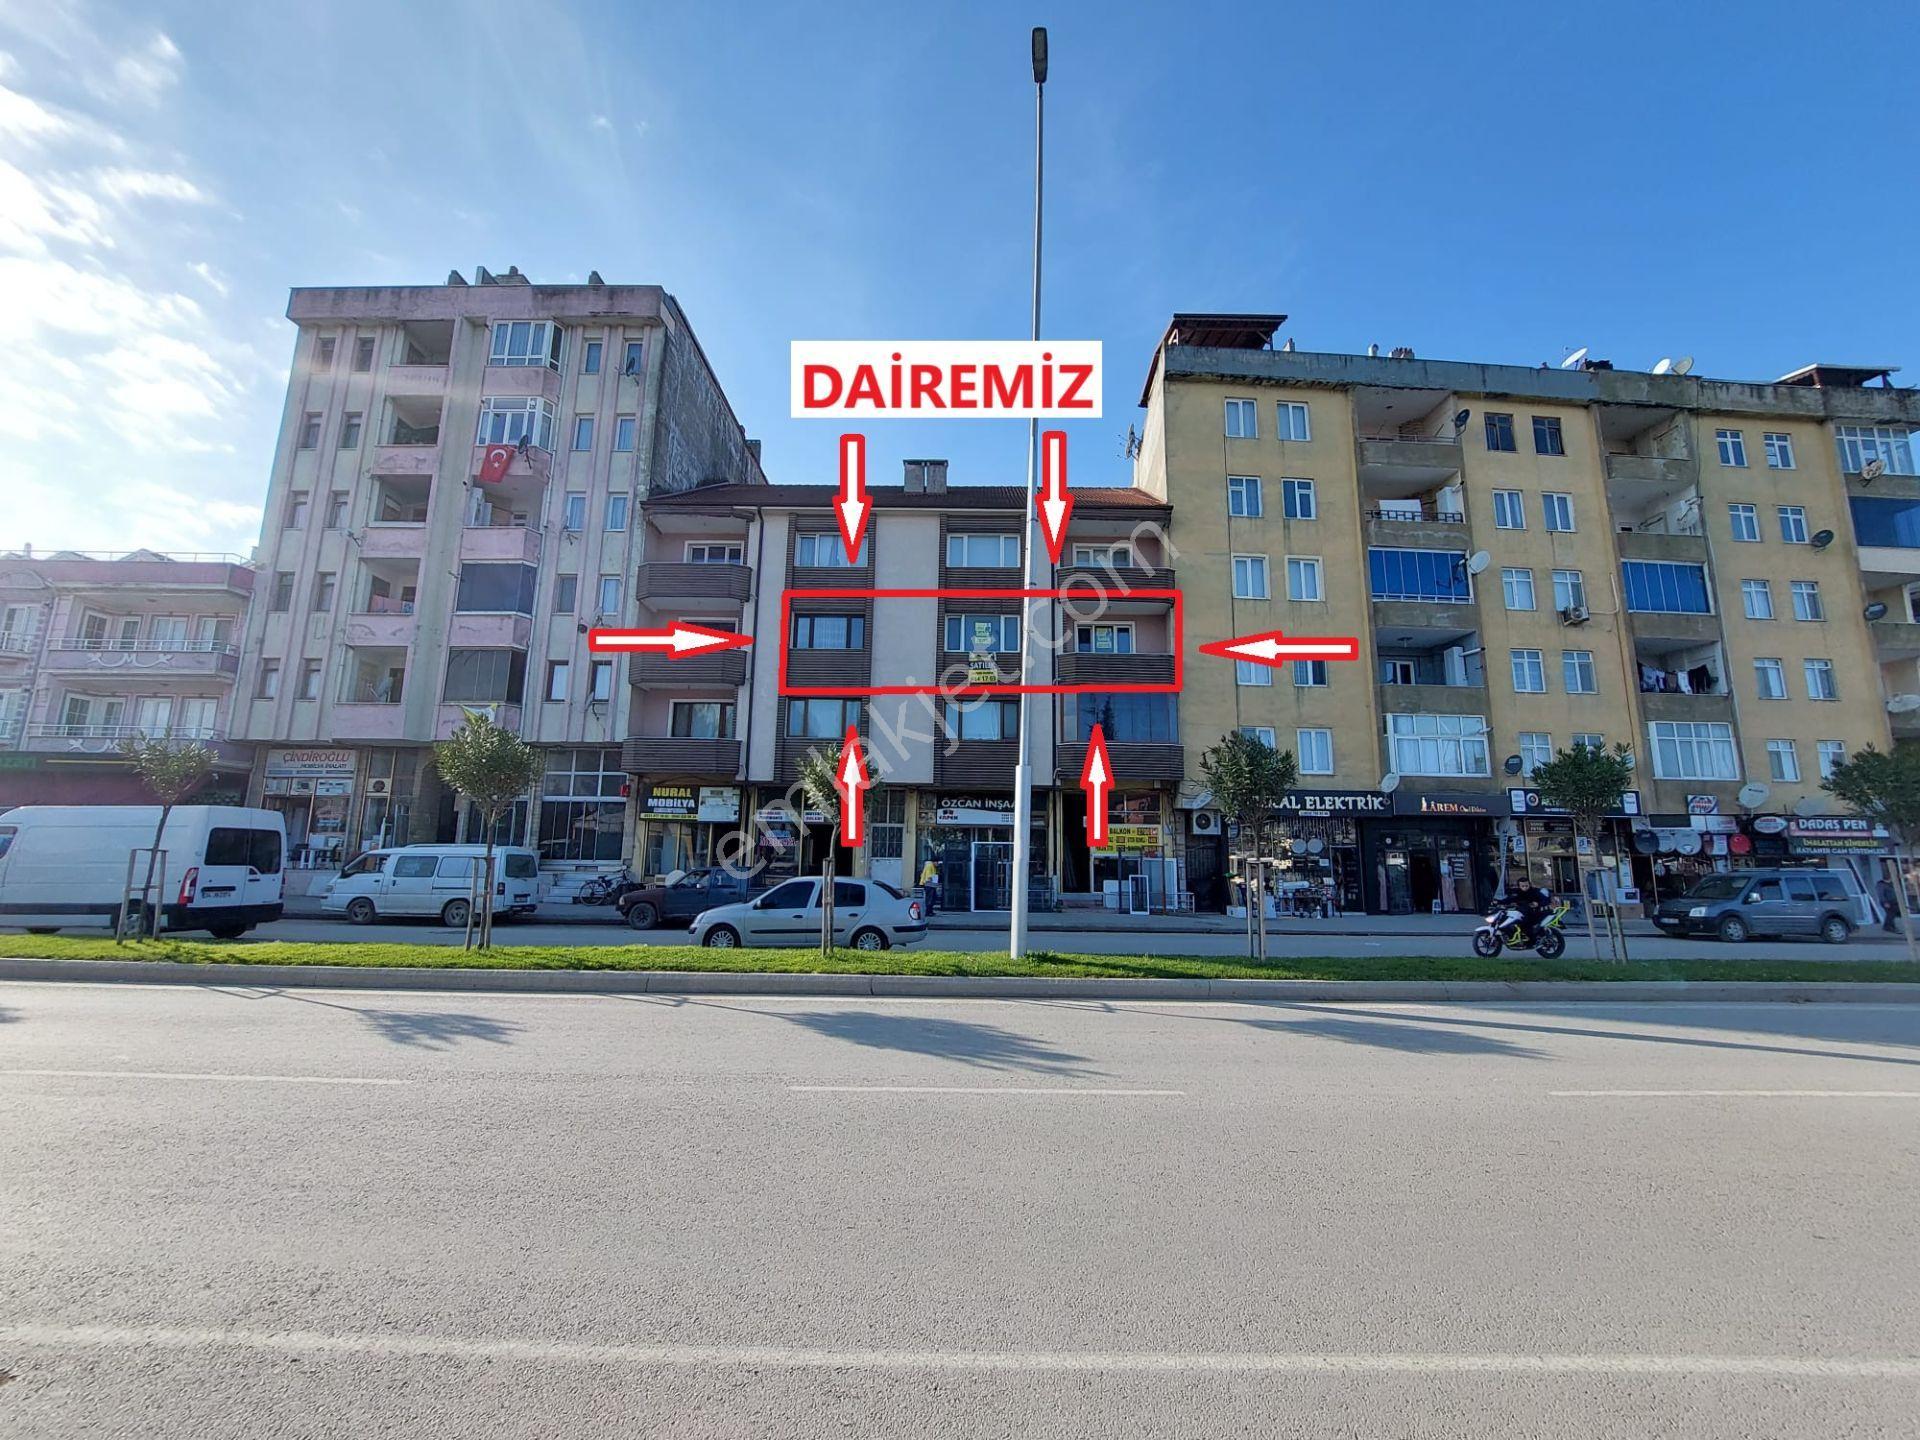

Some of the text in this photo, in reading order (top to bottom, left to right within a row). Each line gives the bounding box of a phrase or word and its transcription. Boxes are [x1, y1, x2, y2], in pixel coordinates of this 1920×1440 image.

[283, 751, 351, 763] ÇİNDİROĞLU
[652, 787, 693, 797] NURAL
[647, 798, 695, 808] MOBİLYA
[941, 797, 981, 808] ÖZCAN
[1304, 795, 1385, 810] ELEKTRİK
[1798, 819, 1868, 832] DADAŞ PEN
